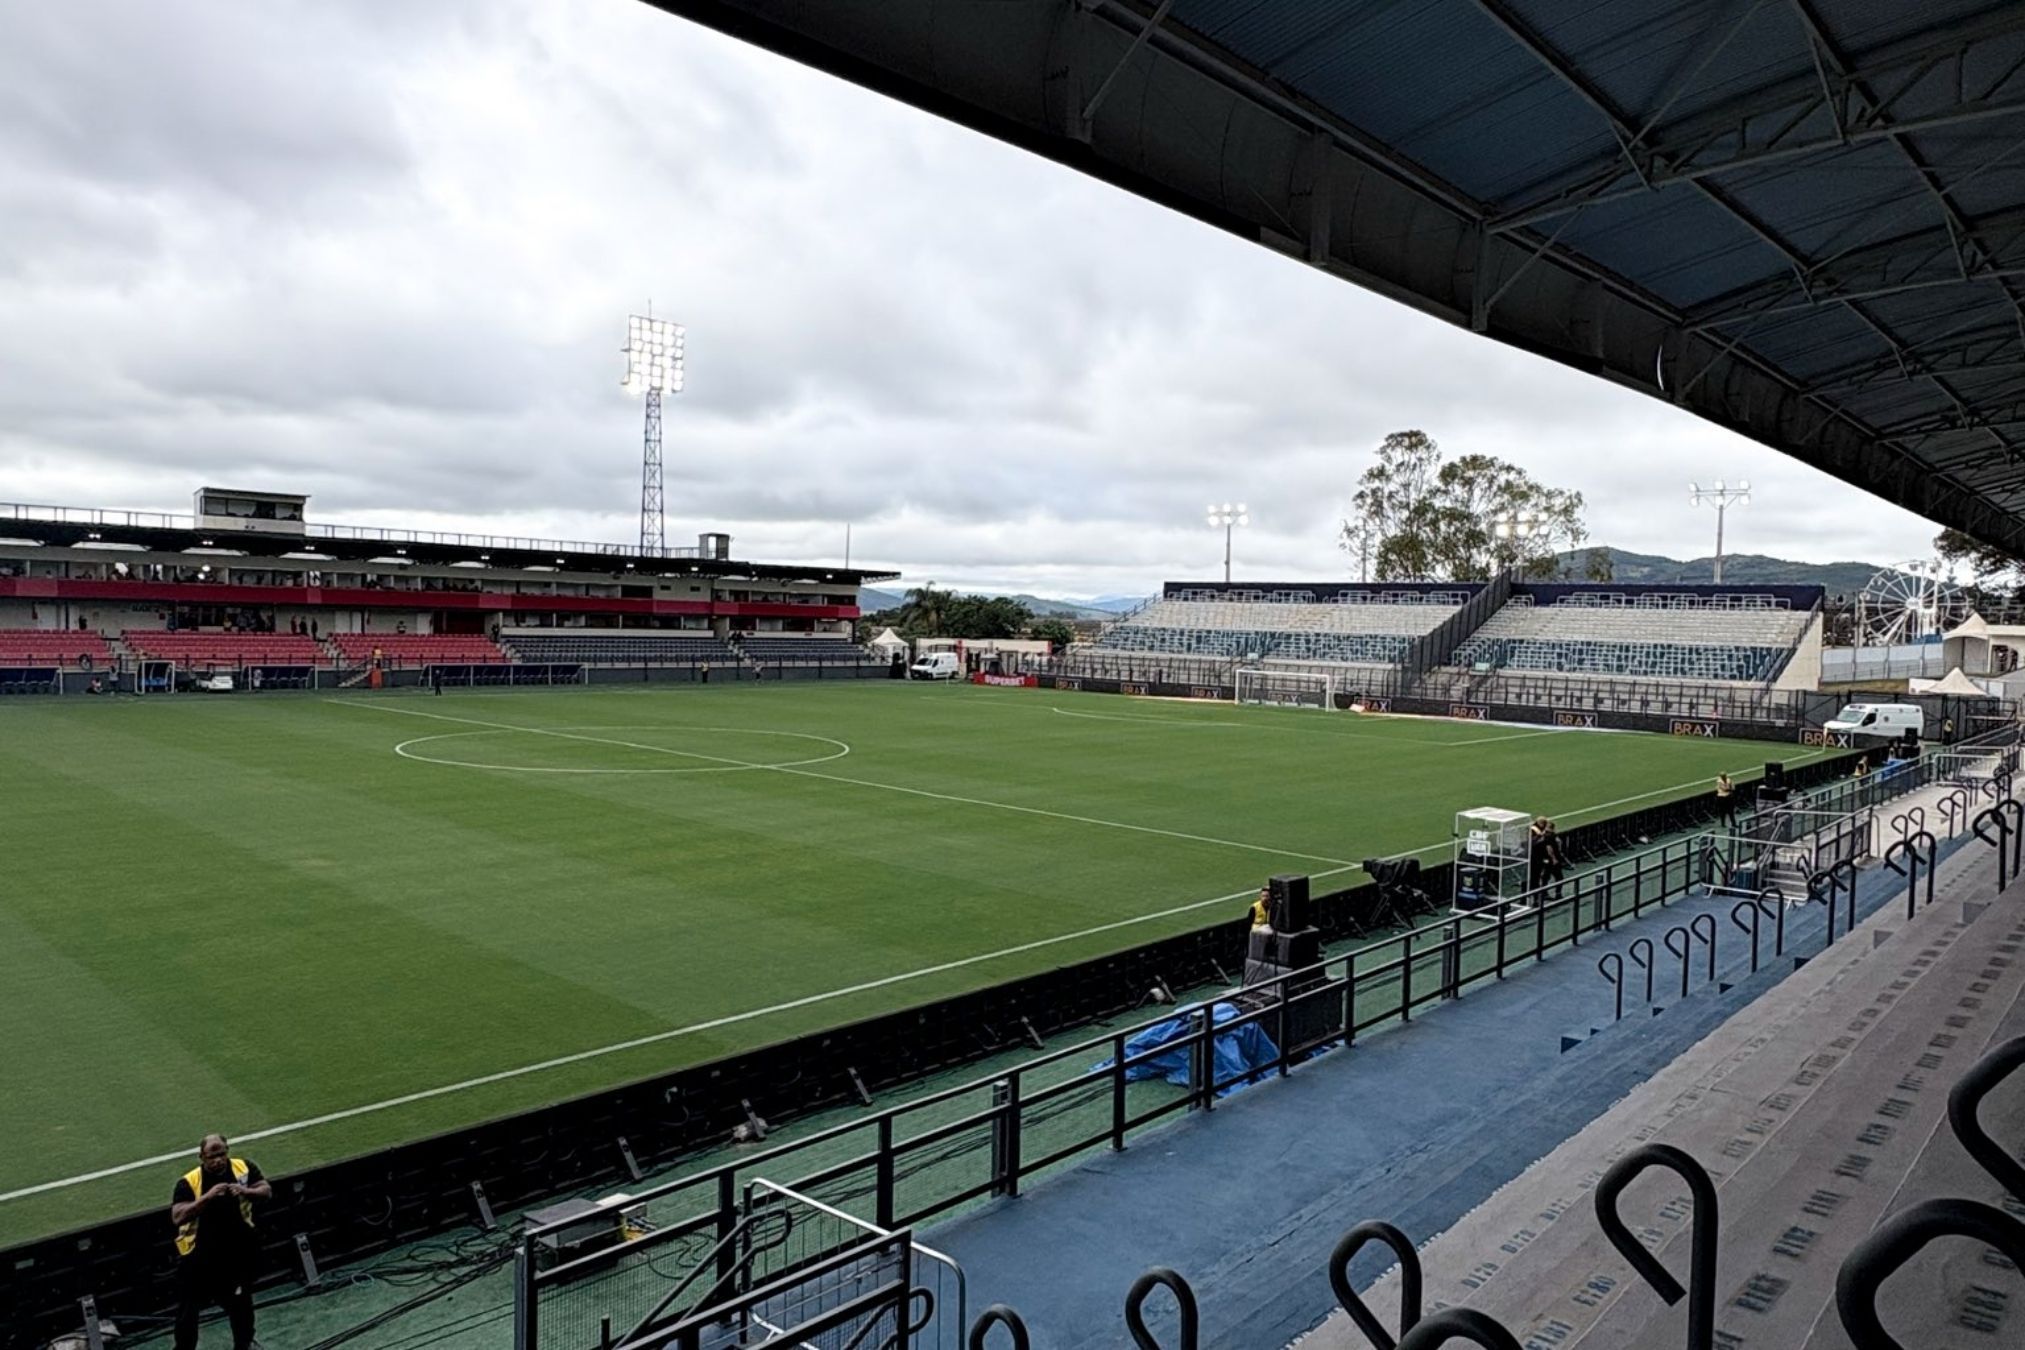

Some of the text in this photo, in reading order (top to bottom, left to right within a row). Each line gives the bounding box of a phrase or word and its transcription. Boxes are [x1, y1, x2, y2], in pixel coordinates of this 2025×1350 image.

[1453, 707, 1485, 720] BRAX
[1557, 714, 1593, 728] BRAX
[1673, 722, 1714, 738] BRAX
[1804, 731, 1848, 748] BRAX
[1572, 1275, 1617, 1307] E180
